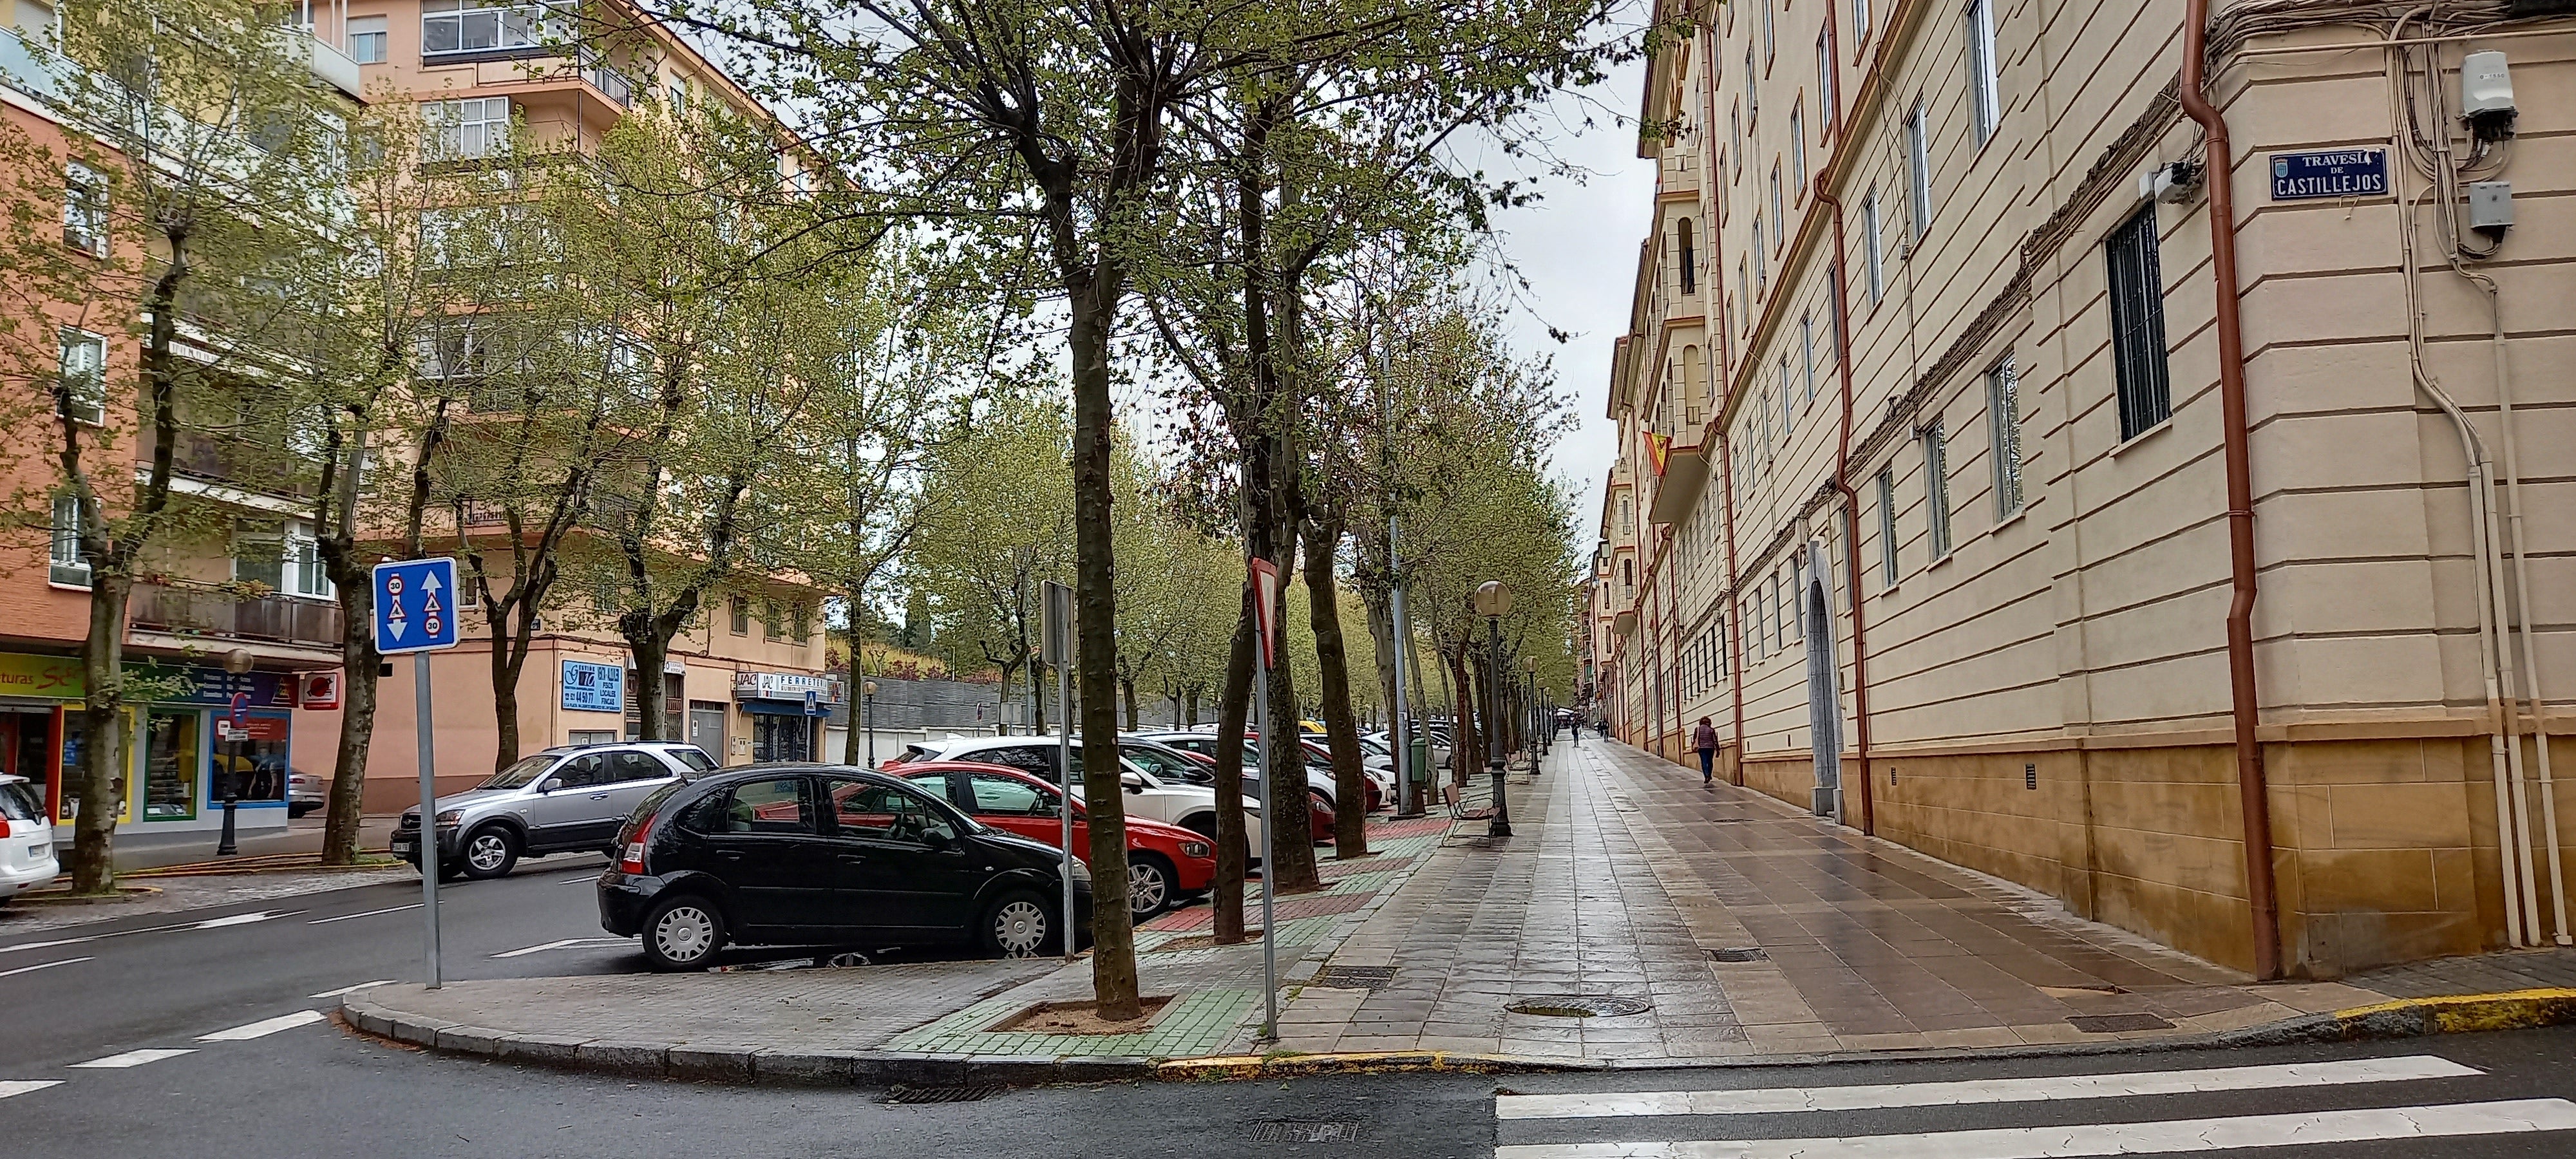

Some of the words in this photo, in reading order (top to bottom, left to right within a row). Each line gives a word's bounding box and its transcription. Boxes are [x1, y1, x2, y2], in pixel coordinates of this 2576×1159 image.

[2277, 174, 2382, 195] CASTILLEJOS
[738, 674, 756, 686] JAC
[762, 675, 773, 689] JAC
